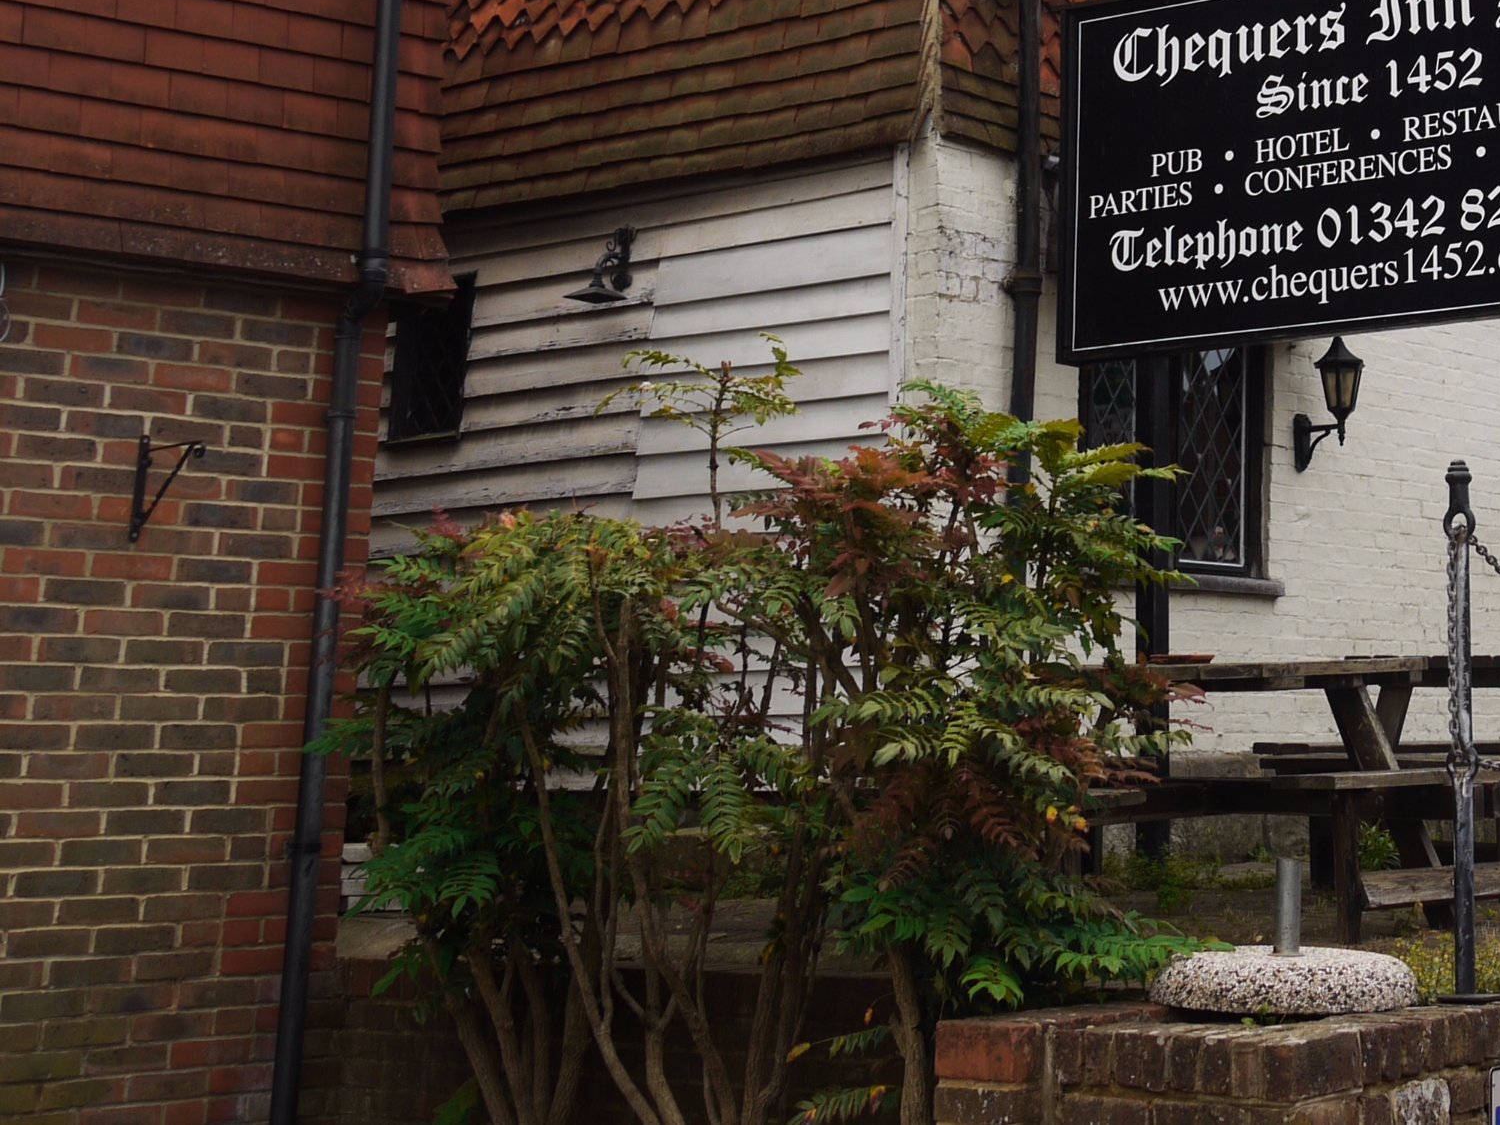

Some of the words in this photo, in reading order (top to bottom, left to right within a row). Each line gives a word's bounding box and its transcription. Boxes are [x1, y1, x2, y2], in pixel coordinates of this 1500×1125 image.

[1113, 1, 1346, 86] Chequers
[1256, 71, 1368, 118] Since
[1386, 48, 1482, 98] 1452
[1089, 181, 1192, 218] PARTIES
[1244, 145, 1451, 196] CONFERENCES
[1151, 149, 1202, 178] PUB
[1256, 128, 1349, 163] HOTEL
[1110, 219, 1303, 272] Telephone
[1317, 195, 1445, 247] 01342
